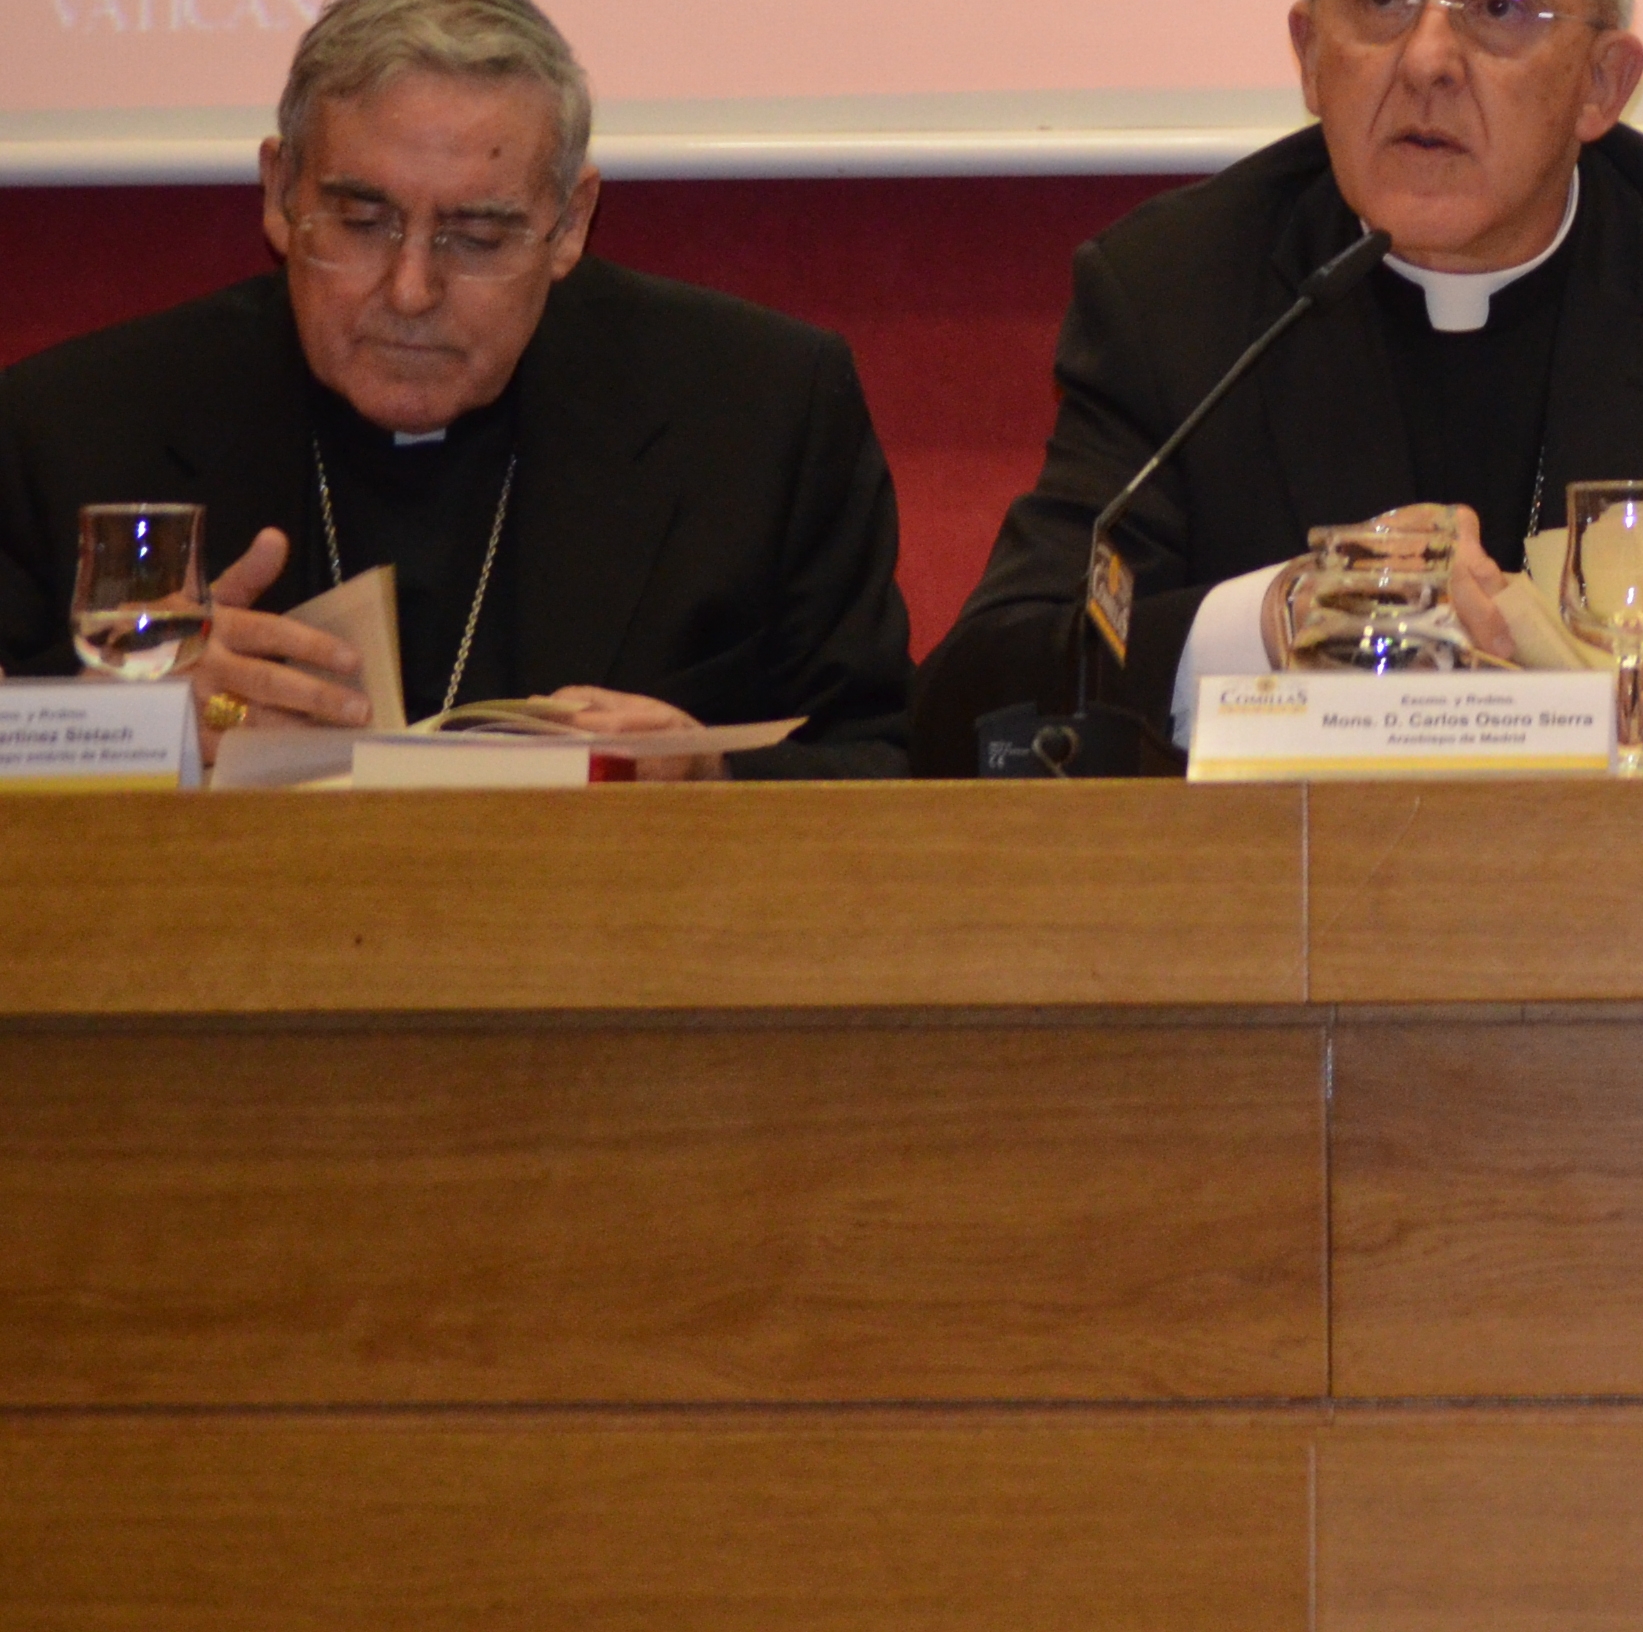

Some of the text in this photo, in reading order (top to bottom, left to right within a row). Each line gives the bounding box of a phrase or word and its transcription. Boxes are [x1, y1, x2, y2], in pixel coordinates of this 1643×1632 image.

[1322, 711, 1594, 728] Mons. D. Carlos Osoro Sierra
[1459, 733, 1475, 744] de
[1480, 733, 1526, 744] Madrid
